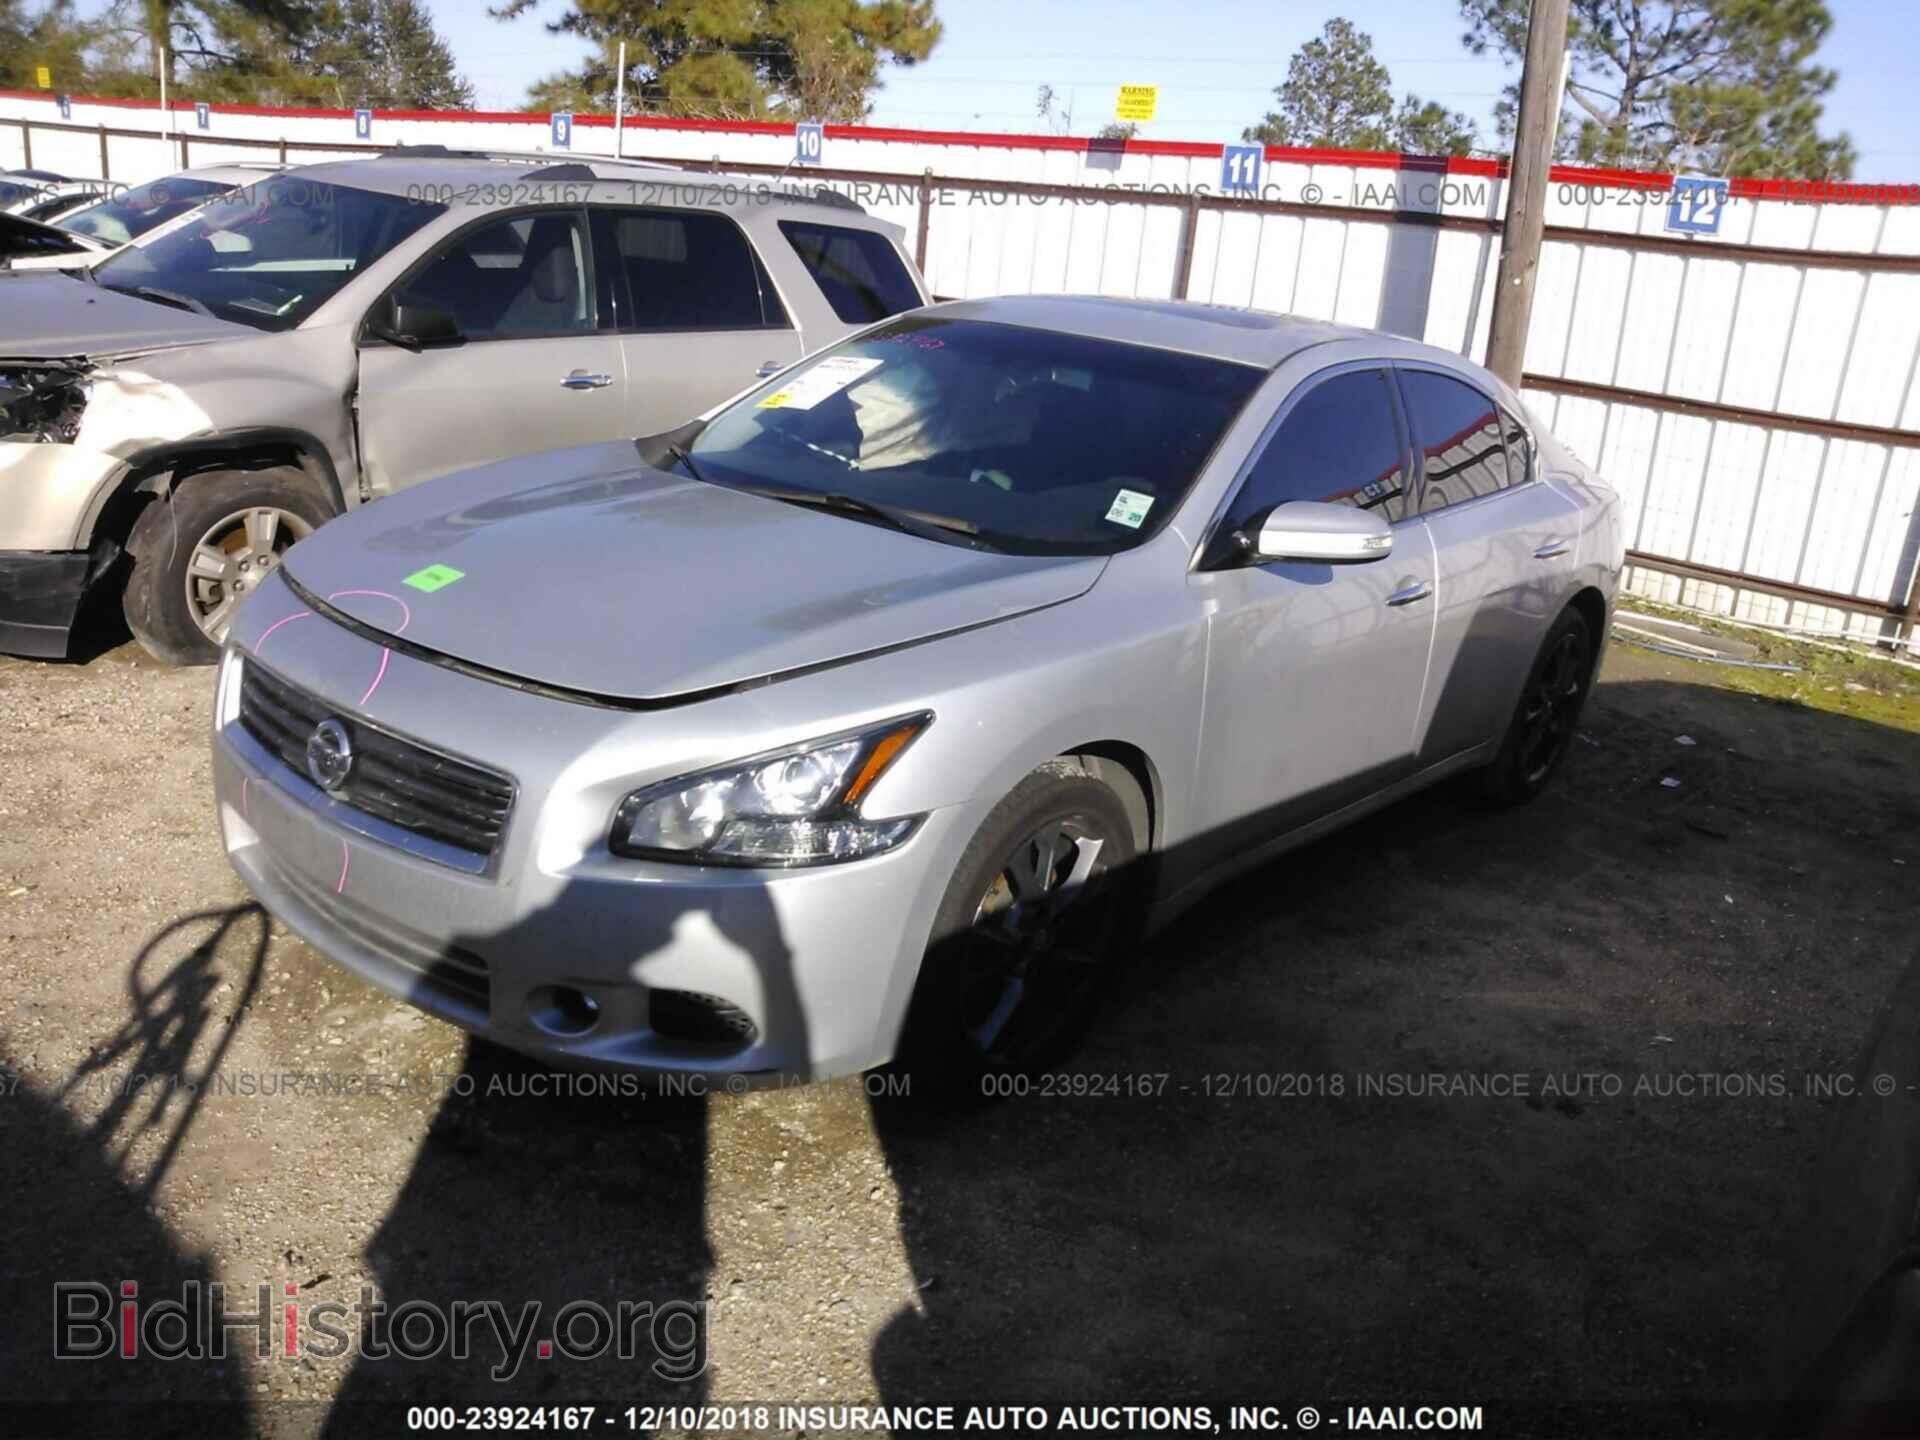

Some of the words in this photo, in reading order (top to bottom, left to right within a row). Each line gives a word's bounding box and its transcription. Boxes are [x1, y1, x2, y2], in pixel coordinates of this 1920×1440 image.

[557, 119, 566, 142] 9
[800, 130, 819, 157] 10
[1229, 152, 1256, 184] 11
[1679, 189, 1716, 224] 12
